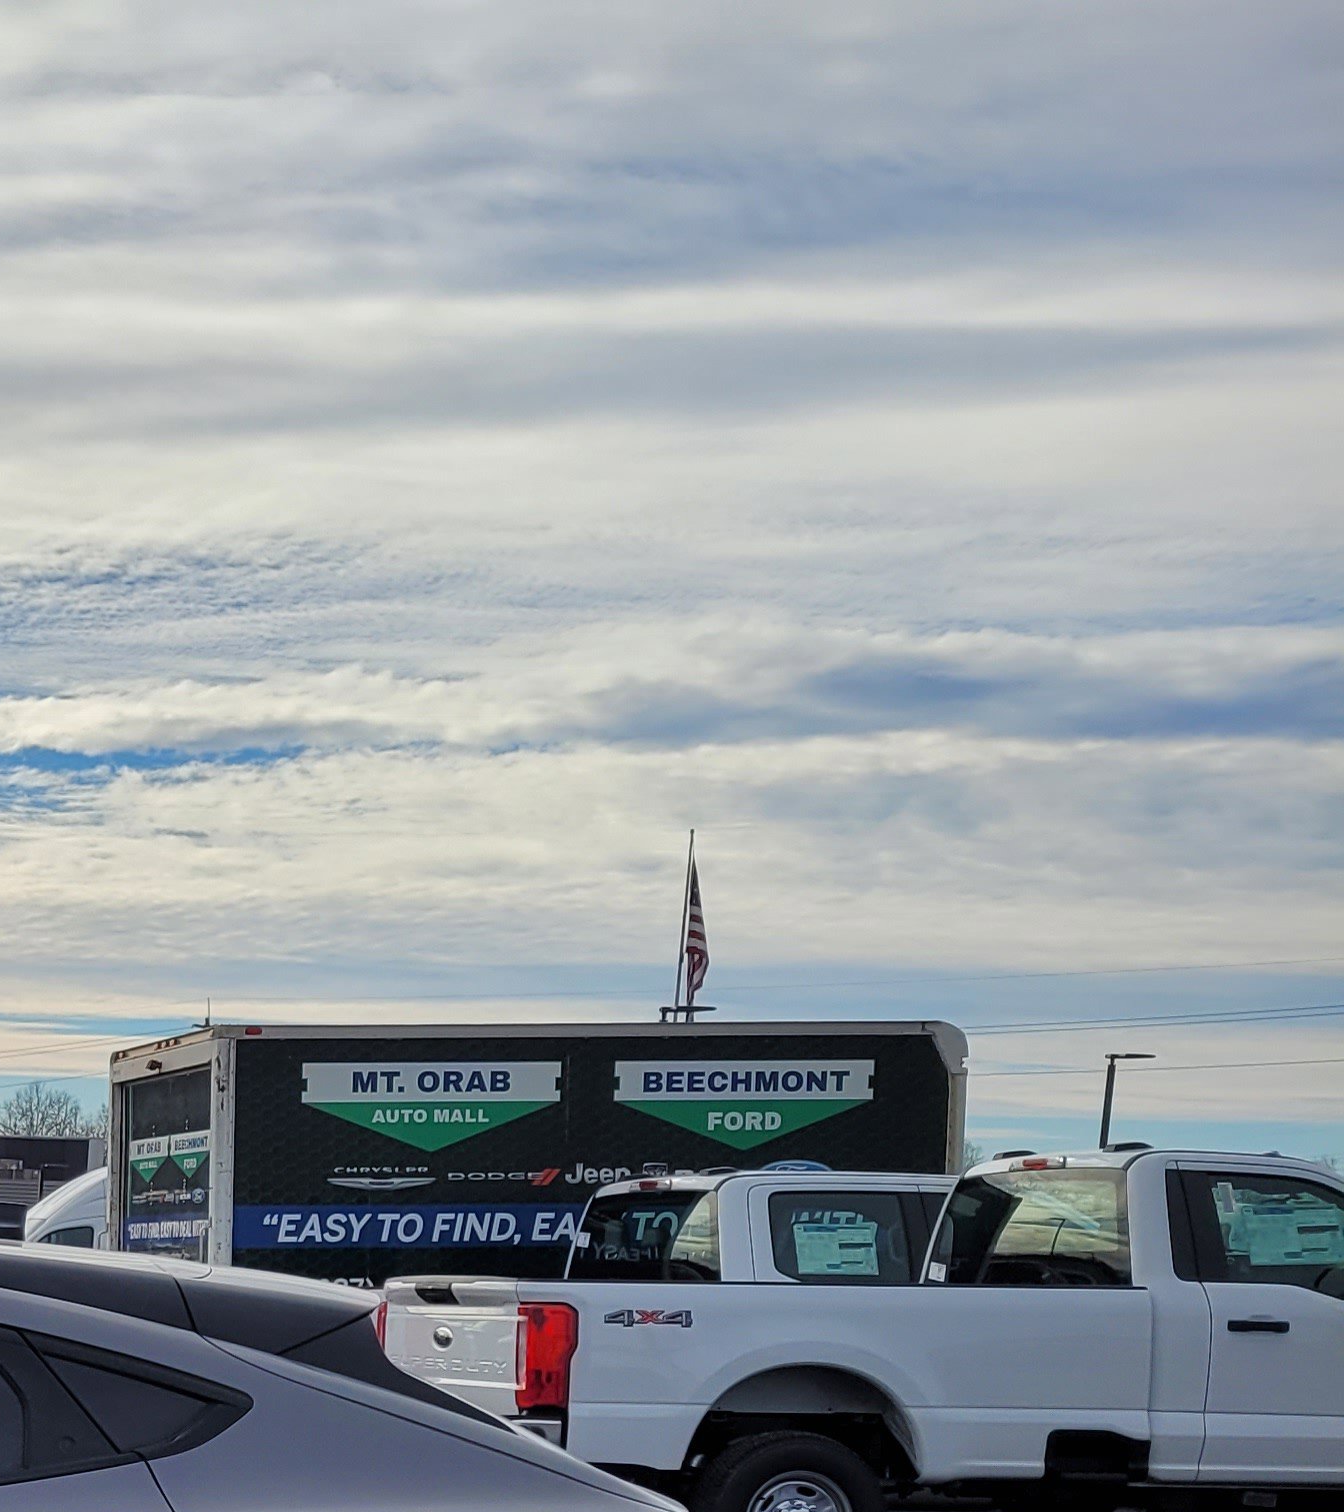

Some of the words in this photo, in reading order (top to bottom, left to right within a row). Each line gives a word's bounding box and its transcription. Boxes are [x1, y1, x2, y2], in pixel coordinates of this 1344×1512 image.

[352, 1071, 405, 1093] MT.
[417, 1070, 511, 1093] ORAB
[643, 1070, 851, 1093] BEECHMONT
[372, 1109, 427, 1123] AUTO
[433, 1109, 489, 1123] MALL
[707, 1111, 782, 1131] FORD
[447, 1172, 544, 1181] DODGE
[377, 1213, 424, 1243] TO
[431, 1212, 522, 1245] FIND,
